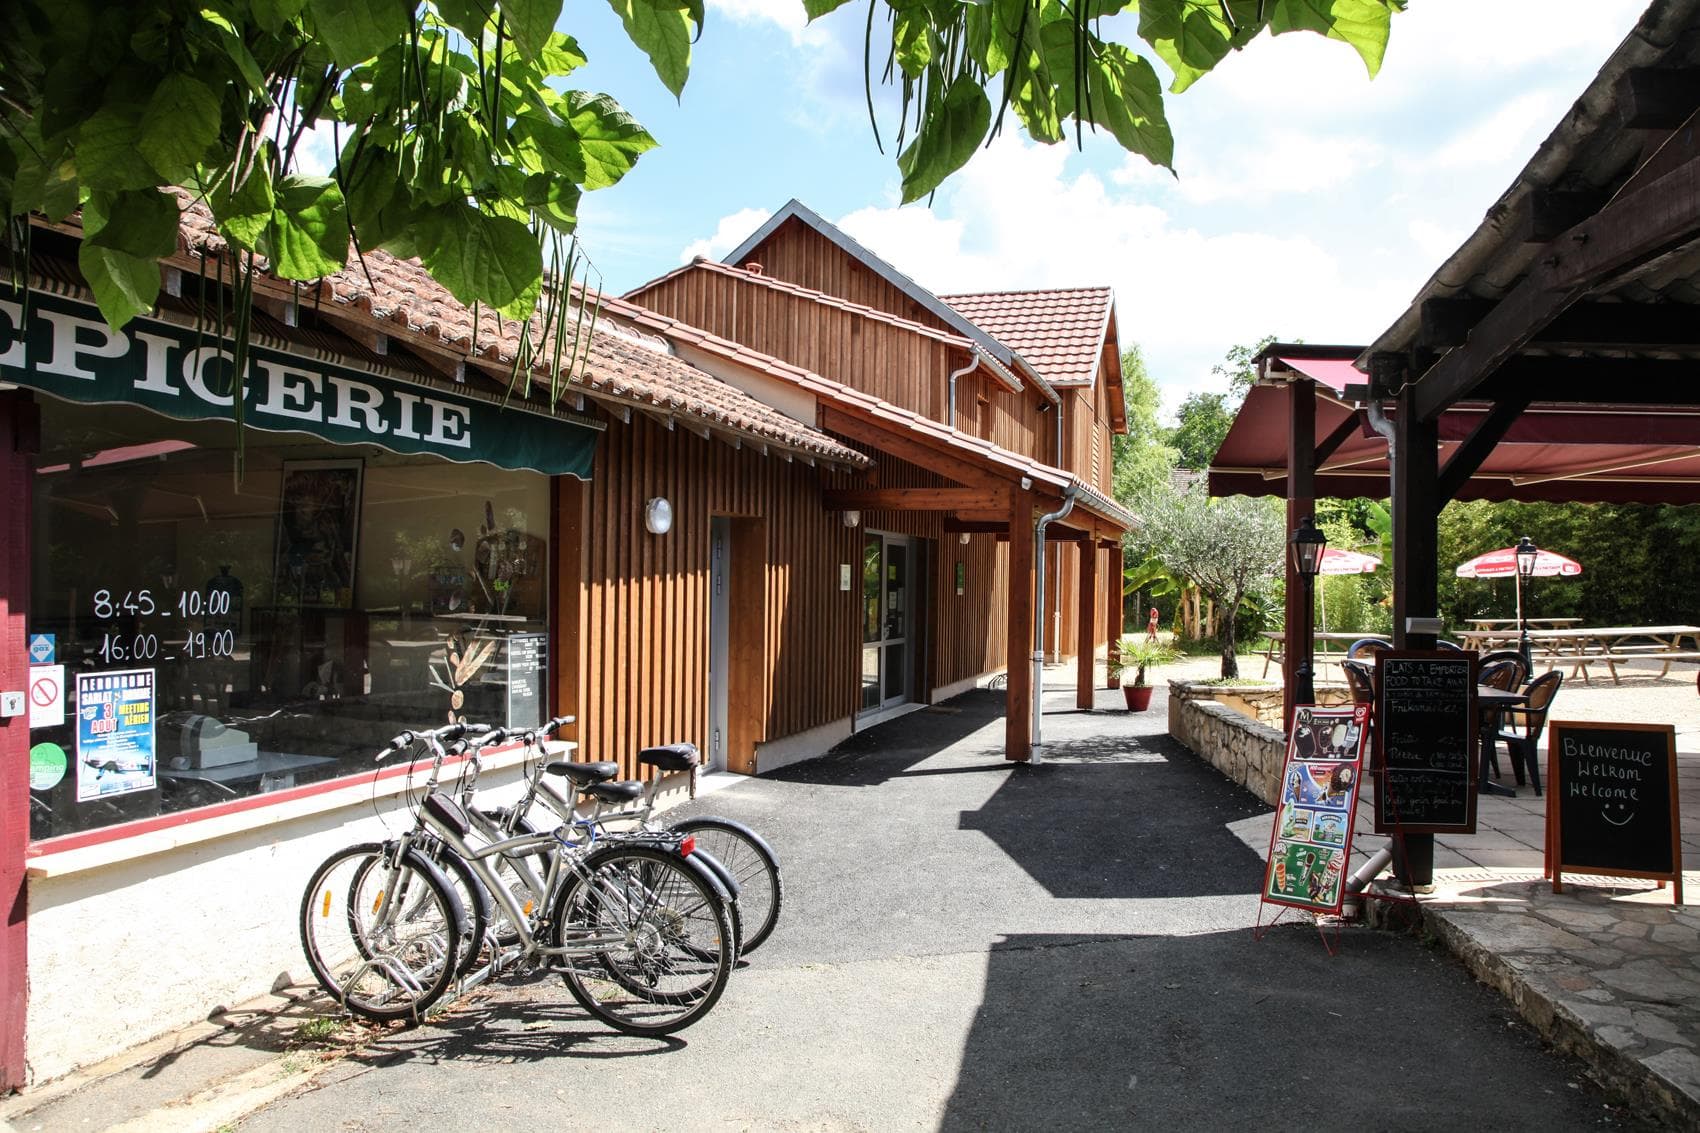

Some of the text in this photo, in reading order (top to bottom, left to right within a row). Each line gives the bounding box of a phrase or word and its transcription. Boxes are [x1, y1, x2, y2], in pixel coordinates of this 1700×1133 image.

[94, 590, 155, 618] 8:45
[178, 590, 230, 618] 10:00
[99, 633, 158, 664] 16:00
[183, 629, 234, 658] 19:00
[104, 703, 112, 718] 3
[1563, 737, 1652, 766] Bienvenue
